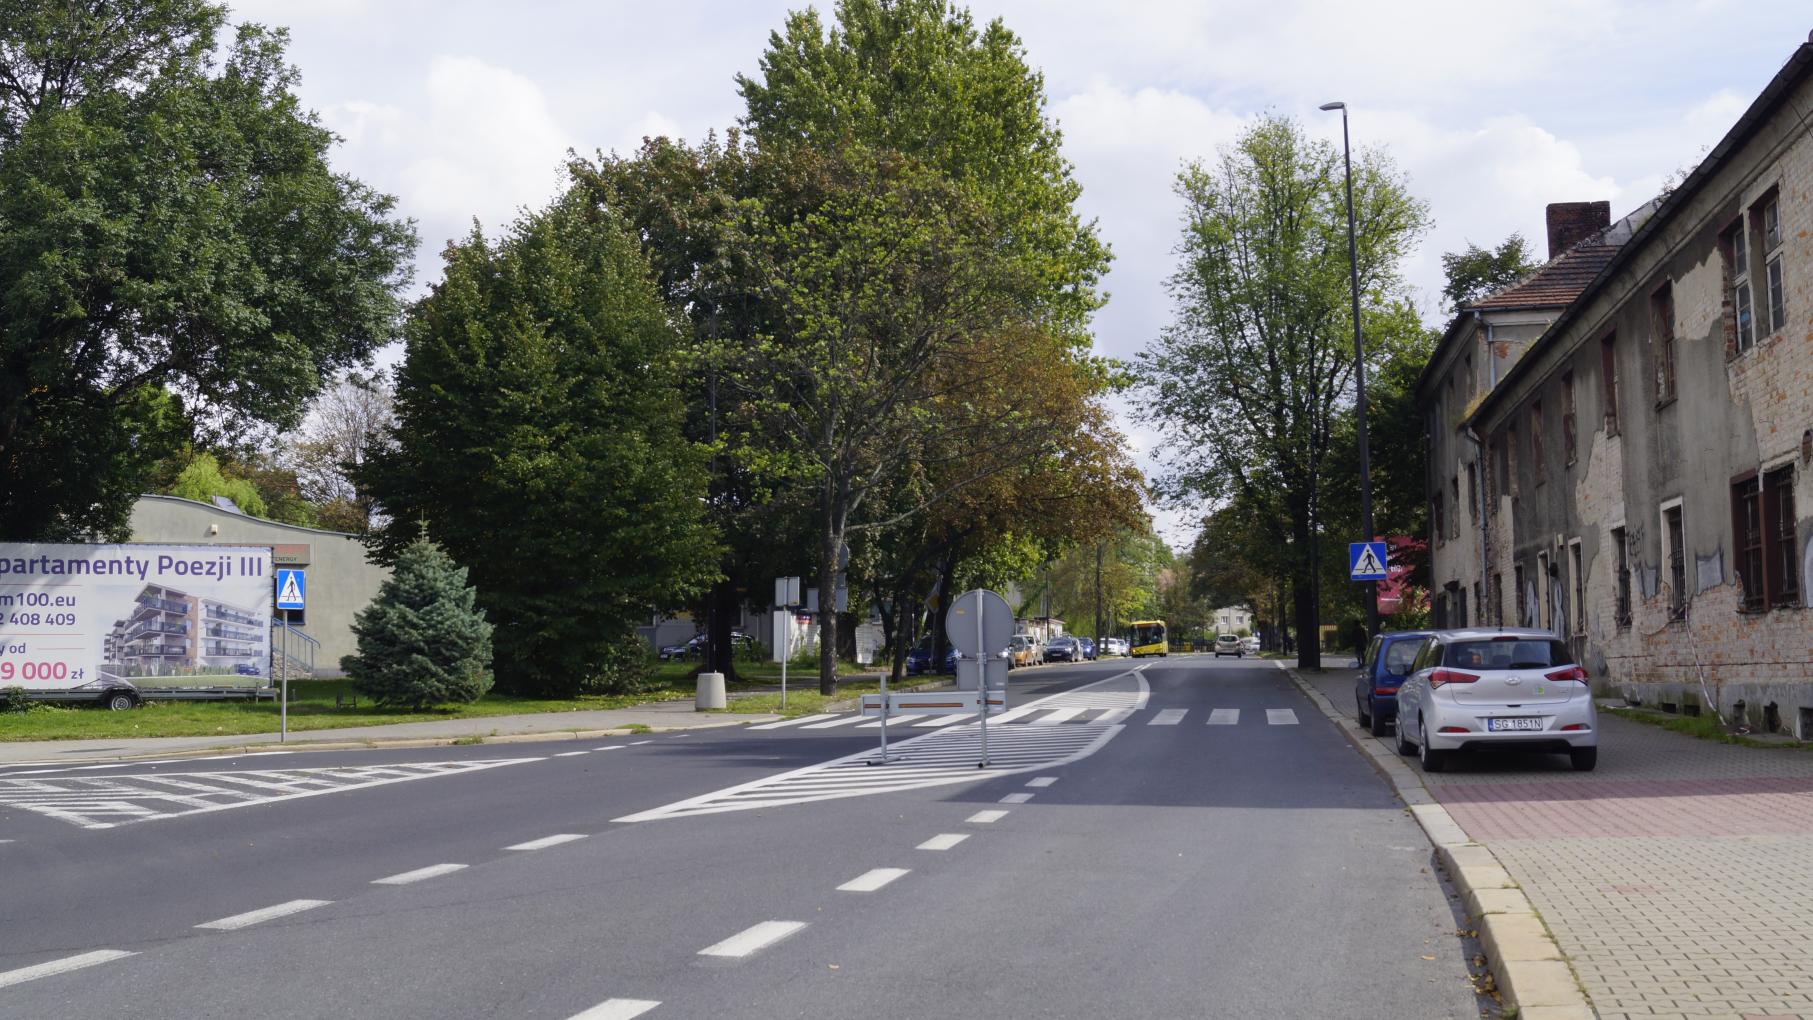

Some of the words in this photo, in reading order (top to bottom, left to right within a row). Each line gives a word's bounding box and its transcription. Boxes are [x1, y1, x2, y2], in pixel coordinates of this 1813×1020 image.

[0, 555, 149, 581] partamenty
[158, 555, 232, 581] Poezji
[240, 556, 262, 577] III
[9, 612, 41, 626] 408
[45, 612, 76, 626] 409
[9, 643, 26, 654] od
[0, 661, 15, 680] 9
[22, 661, 67, 681] 000
[71, 667, 84, 680] zł
[1494, 719, 1509, 729] SG
[1512, 719, 1541, 729] 1851N
